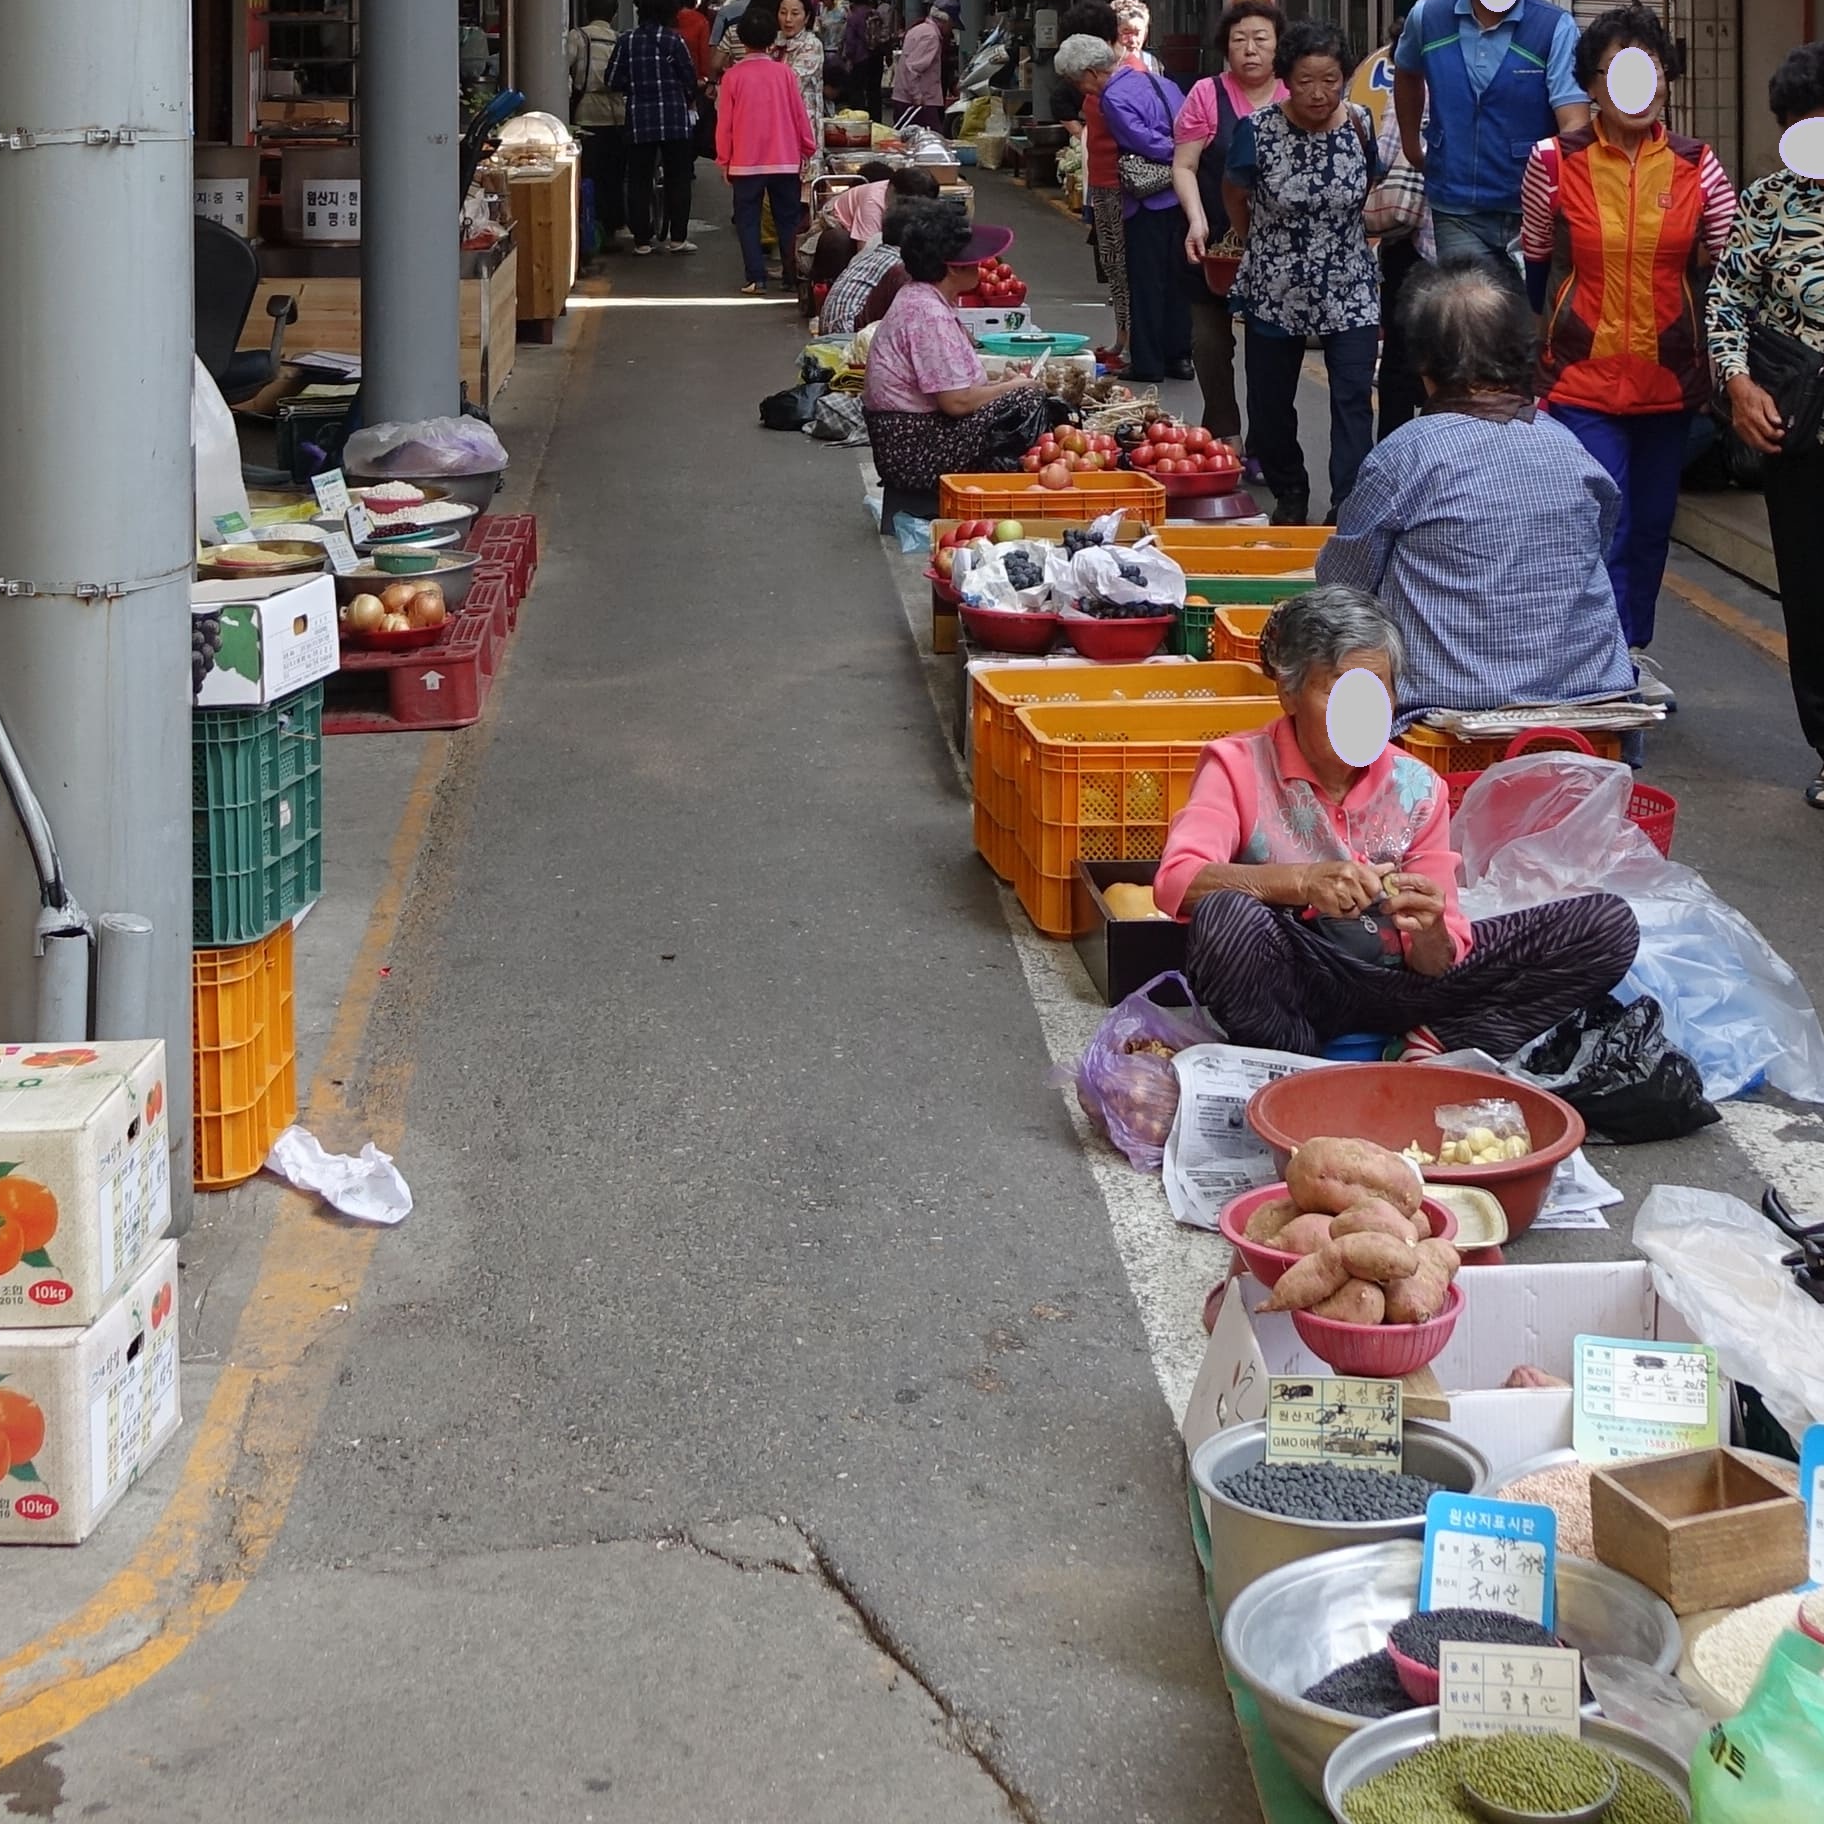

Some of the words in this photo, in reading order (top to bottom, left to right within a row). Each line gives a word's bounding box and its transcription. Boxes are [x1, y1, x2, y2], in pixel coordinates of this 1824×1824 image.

[34, 1284, 68, 1302] 10kg
[21, 1499, 54, 1516] 10kg
[1448, 1507, 1536, 1536] 원산지표시판
